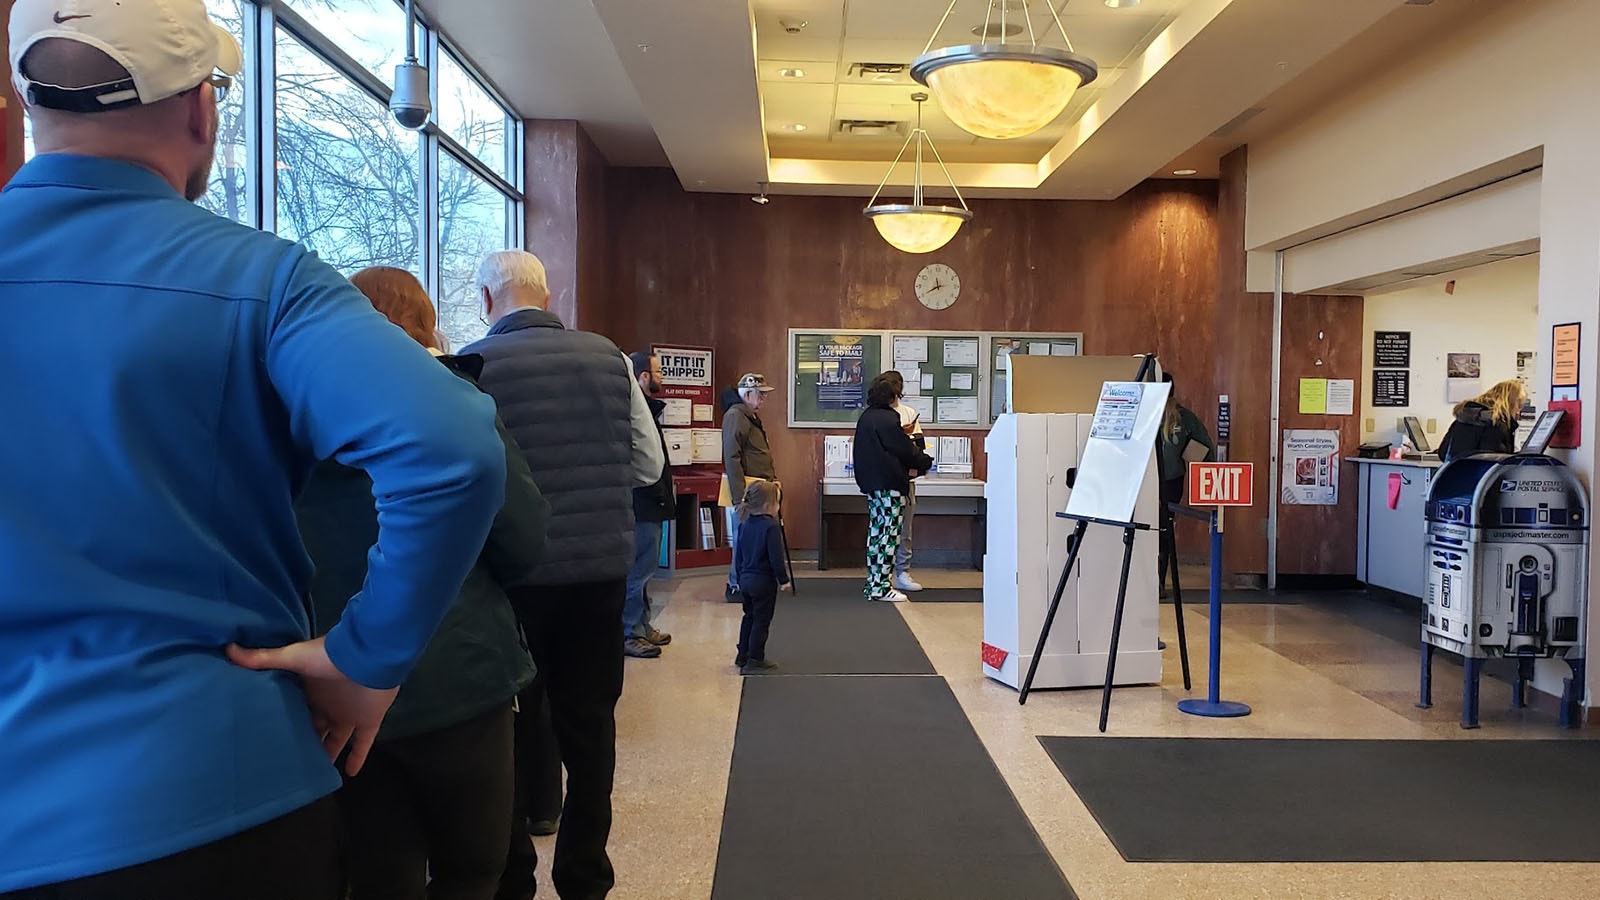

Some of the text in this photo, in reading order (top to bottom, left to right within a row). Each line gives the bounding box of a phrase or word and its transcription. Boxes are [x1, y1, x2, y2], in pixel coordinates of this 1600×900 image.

[661, 355, 671, 366] IT
[674, 356, 690, 367] FIT
[696, 357, 705, 368] IT
[661, 366, 705, 378] SHIPPED
[1109, 387, 1135, 397] Welcome
[1200, 467, 1243, 501] EXIT
